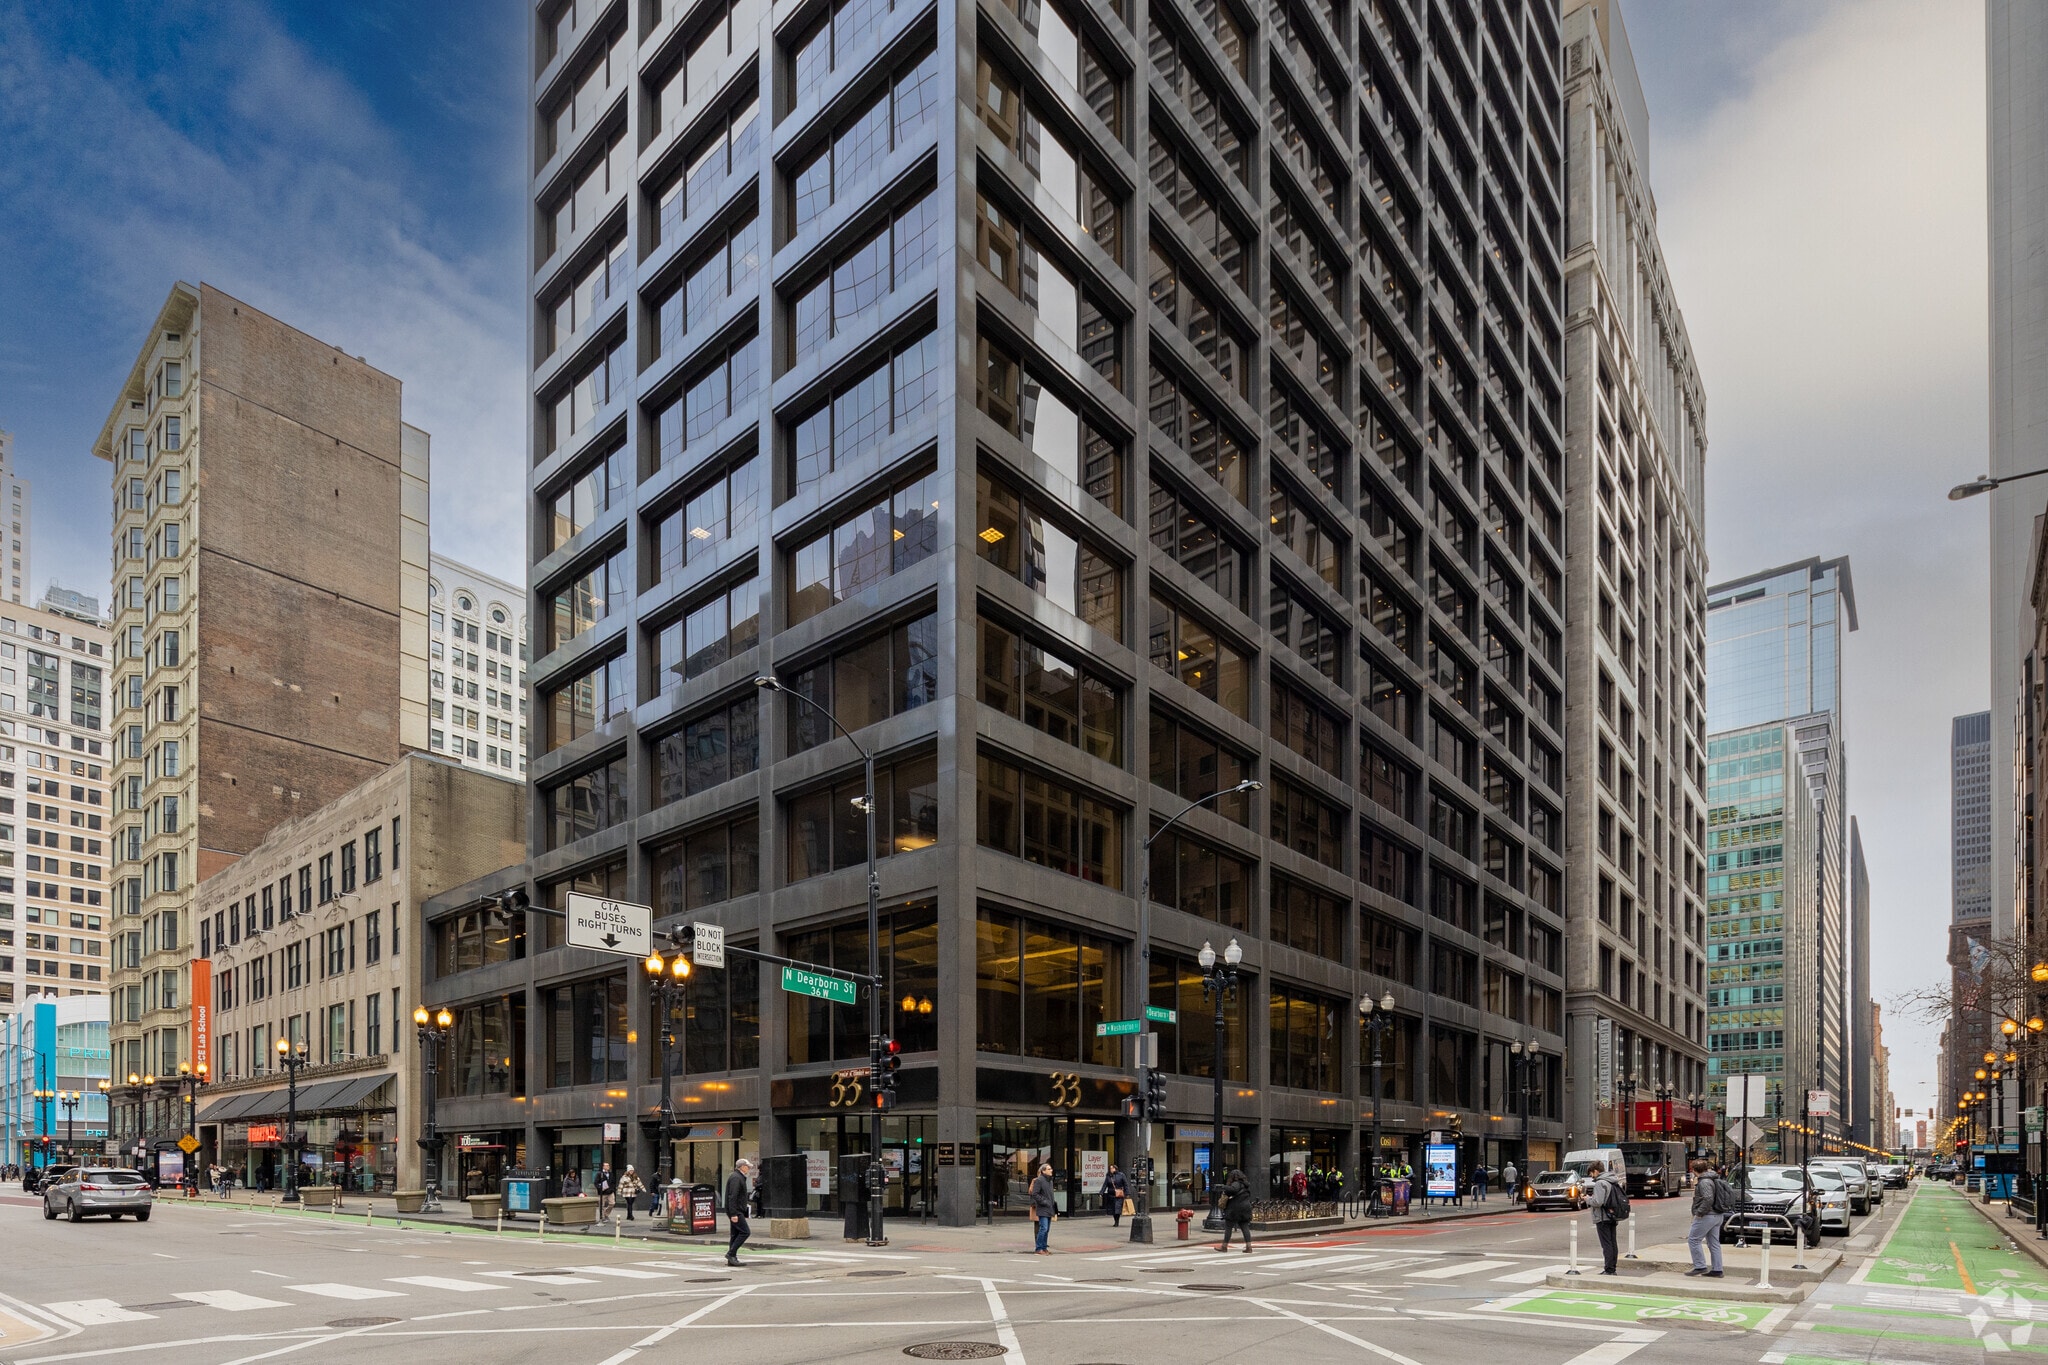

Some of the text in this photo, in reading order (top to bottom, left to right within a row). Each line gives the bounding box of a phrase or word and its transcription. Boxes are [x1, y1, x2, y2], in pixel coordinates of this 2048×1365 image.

[601, 902, 620, 912] CTA
[594, 911, 626, 924] BUSES
[578, 918, 642, 937] RIGHT TURNS
[696, 927, 721, 940] DO NOT
[696, 941, 721, 953] BLOCK
[696, 953, 722, 963] INTERSECTION
[786, 969, 853, 994] N Dearborn St
[811, 986, 829, 998] 36 W
[198, 1006, 206, 1033] School
[198, 1034, 206, 1049] Lab
[1601, 1022, 1609, 1070] UNIVERSITY
[70, 1047, 110, 1059] PRI
[1049, 1071, 1082, 1108] 33
[1650, 1106, 1657, 1122] 1
[1087, 1155, 1101, 1163] Layer
